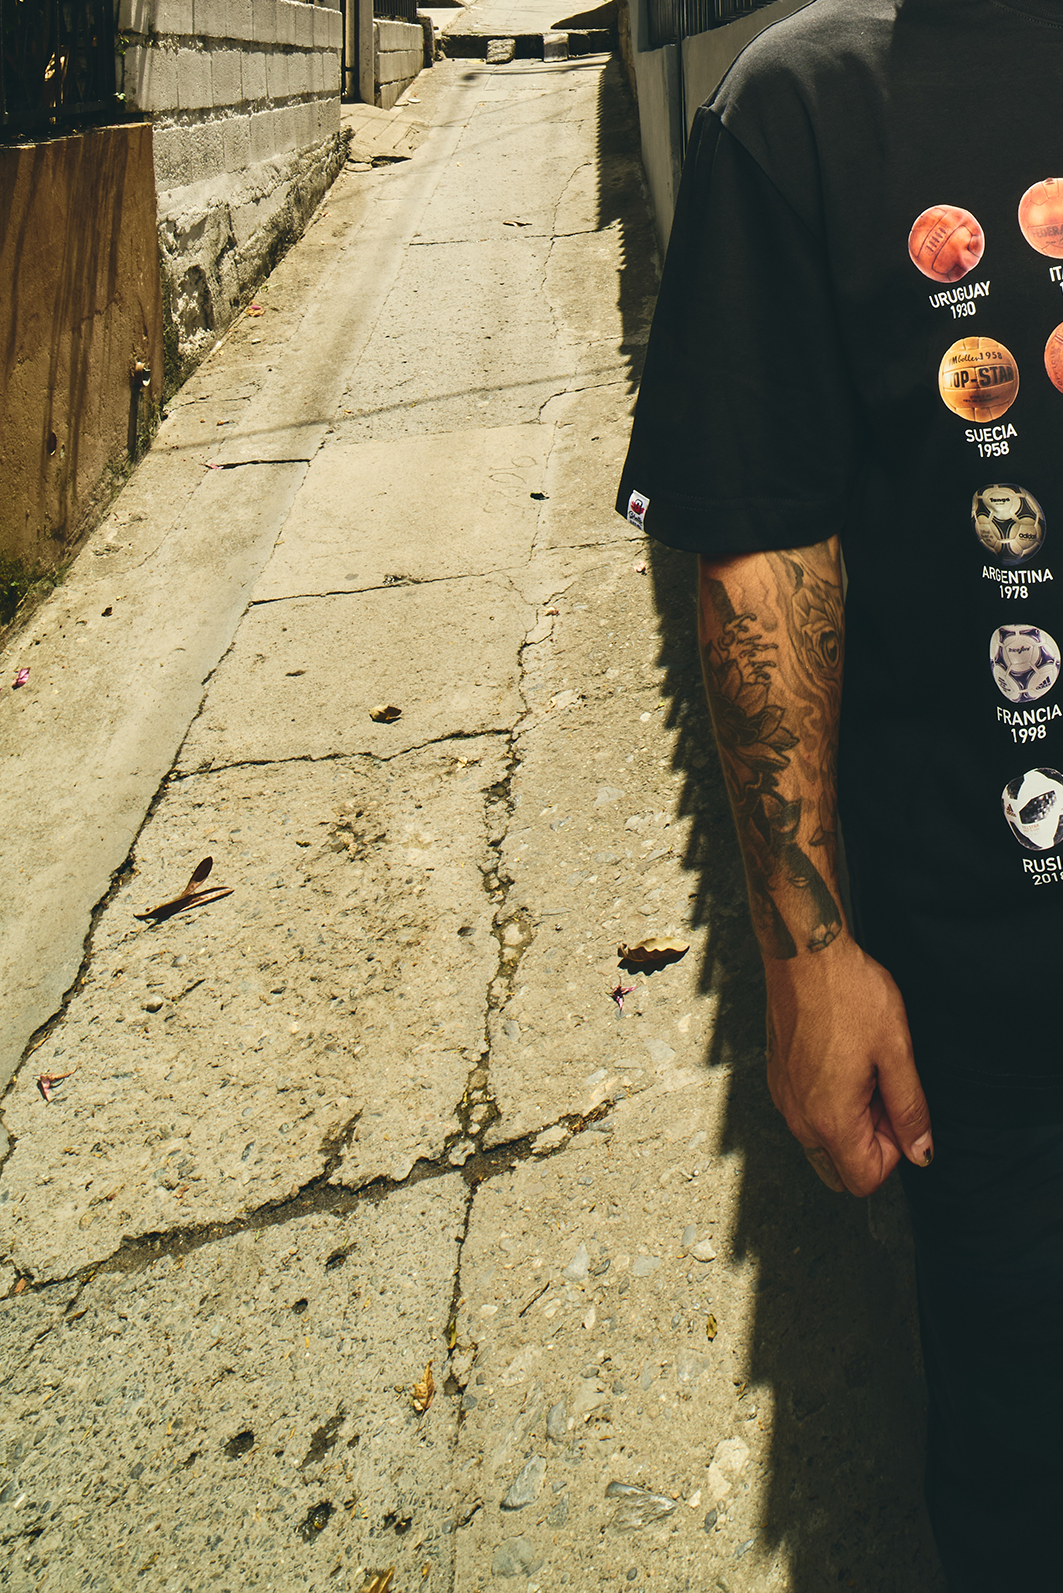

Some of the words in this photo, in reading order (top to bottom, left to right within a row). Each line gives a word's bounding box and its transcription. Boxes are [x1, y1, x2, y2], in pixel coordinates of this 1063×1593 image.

[929, 281, 991, 309] URUGUAY
[950, 302, 976, 319] 1930
[965, 423, 1018, 443] SUECIA
[977, 441, 1010, 458] 1958
[982, 565, 1053, 584] ARGENTINA
[1000, 585, 1029, 599] 1978
[997, 704, 1062, 726] FRANCIA
[1011, 724, 1047, 744] 1998
